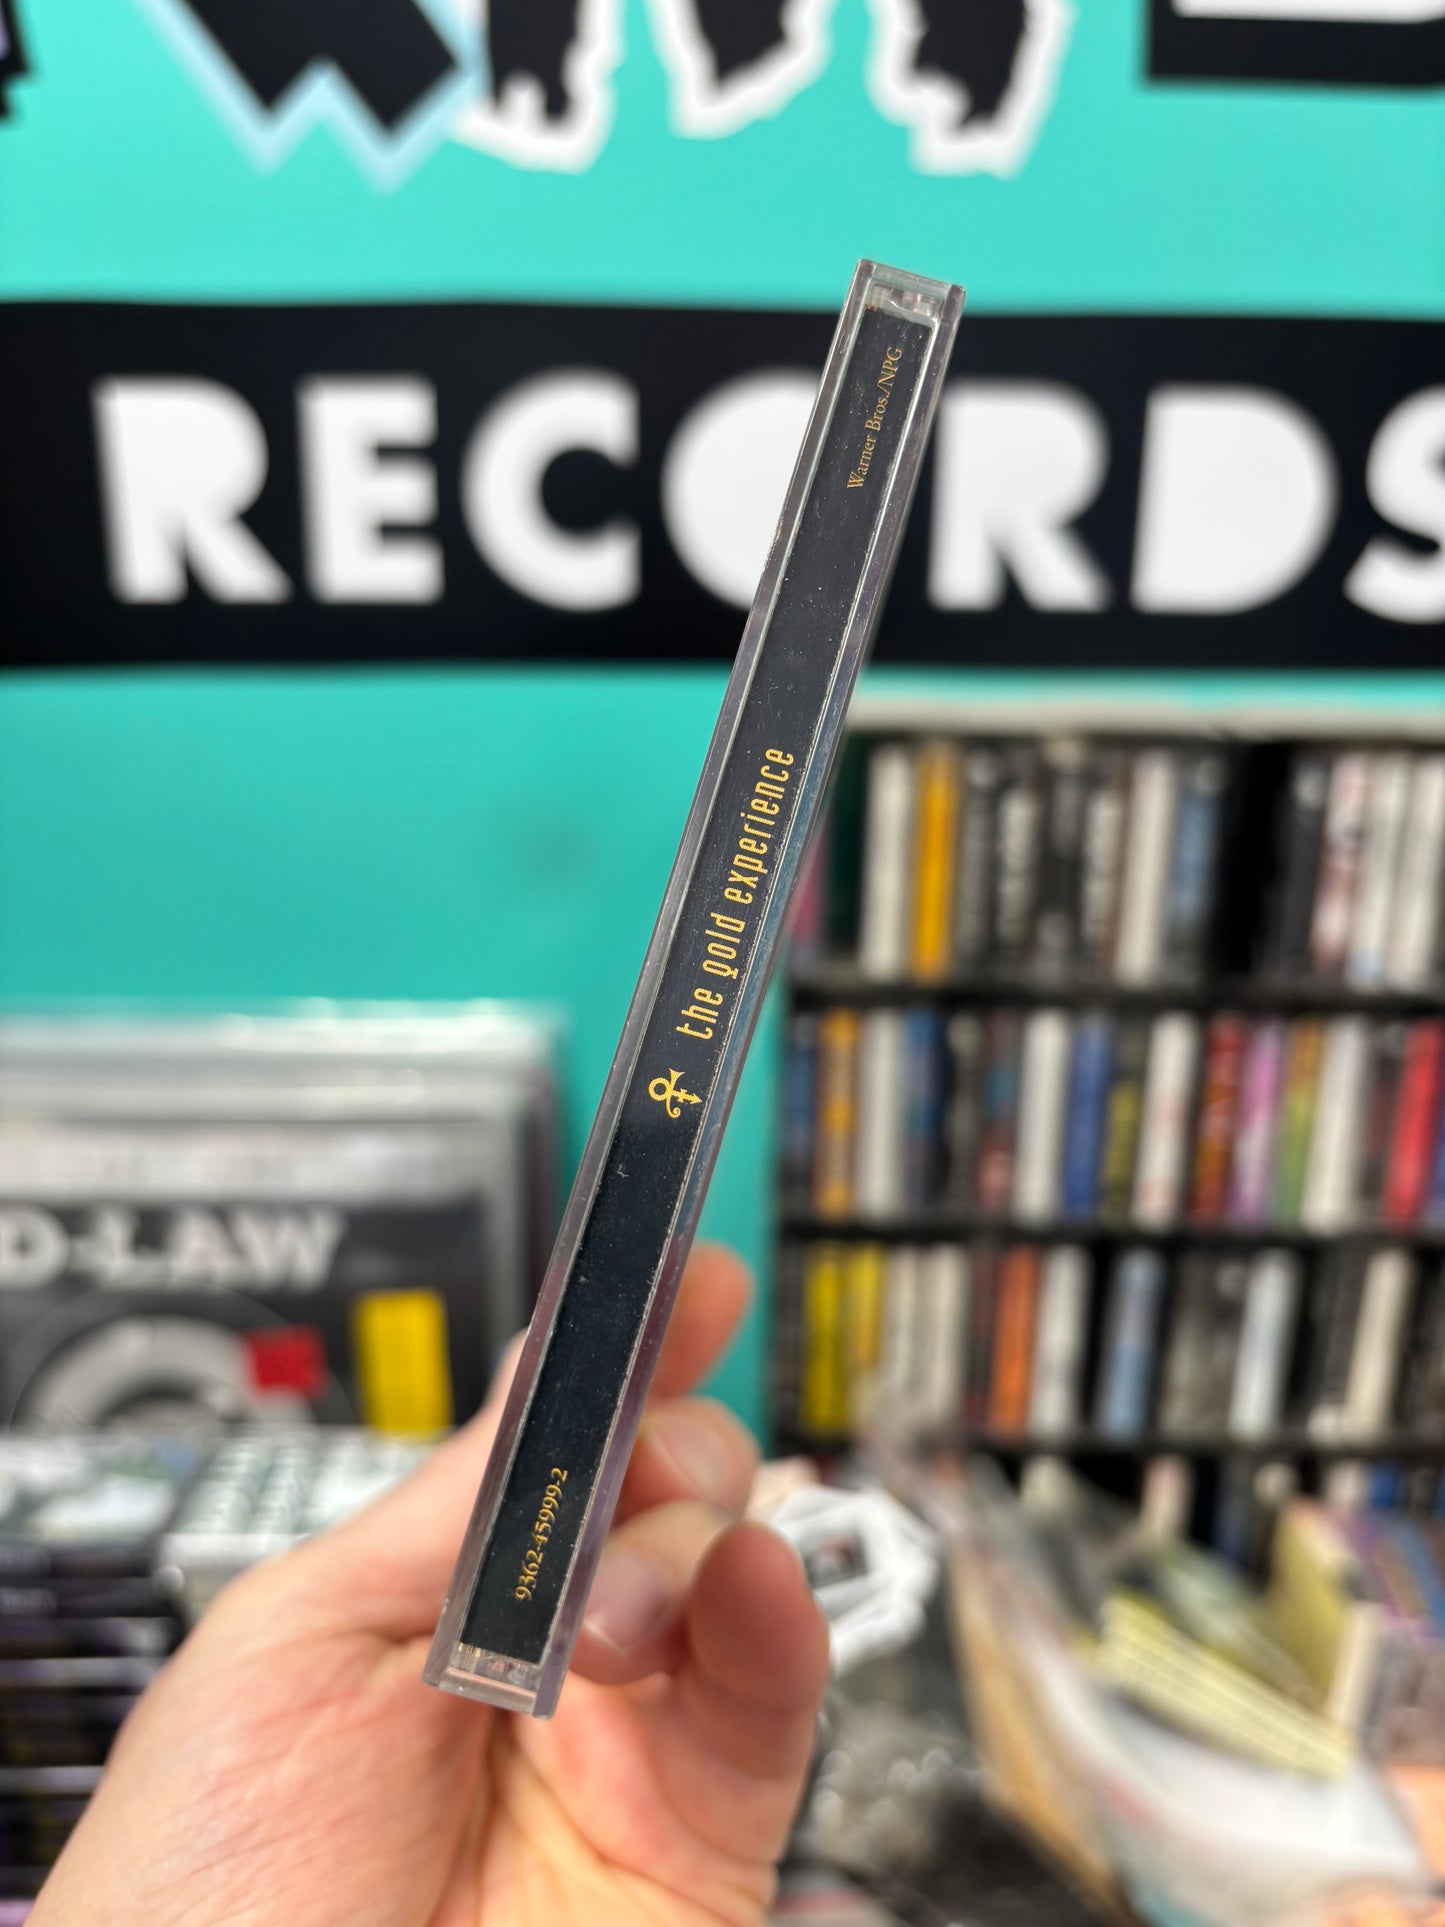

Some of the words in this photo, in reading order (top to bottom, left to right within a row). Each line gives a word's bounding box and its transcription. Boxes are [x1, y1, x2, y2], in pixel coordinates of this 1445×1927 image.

[846, 434, 877, 489] Warner
[864, 346, 904, 431] Bros./NPG
[676, 986, 724, 1041] the
[723, 747, 795, 906] experience
[514, 1467, 568, 1601] 9362-45999-2
